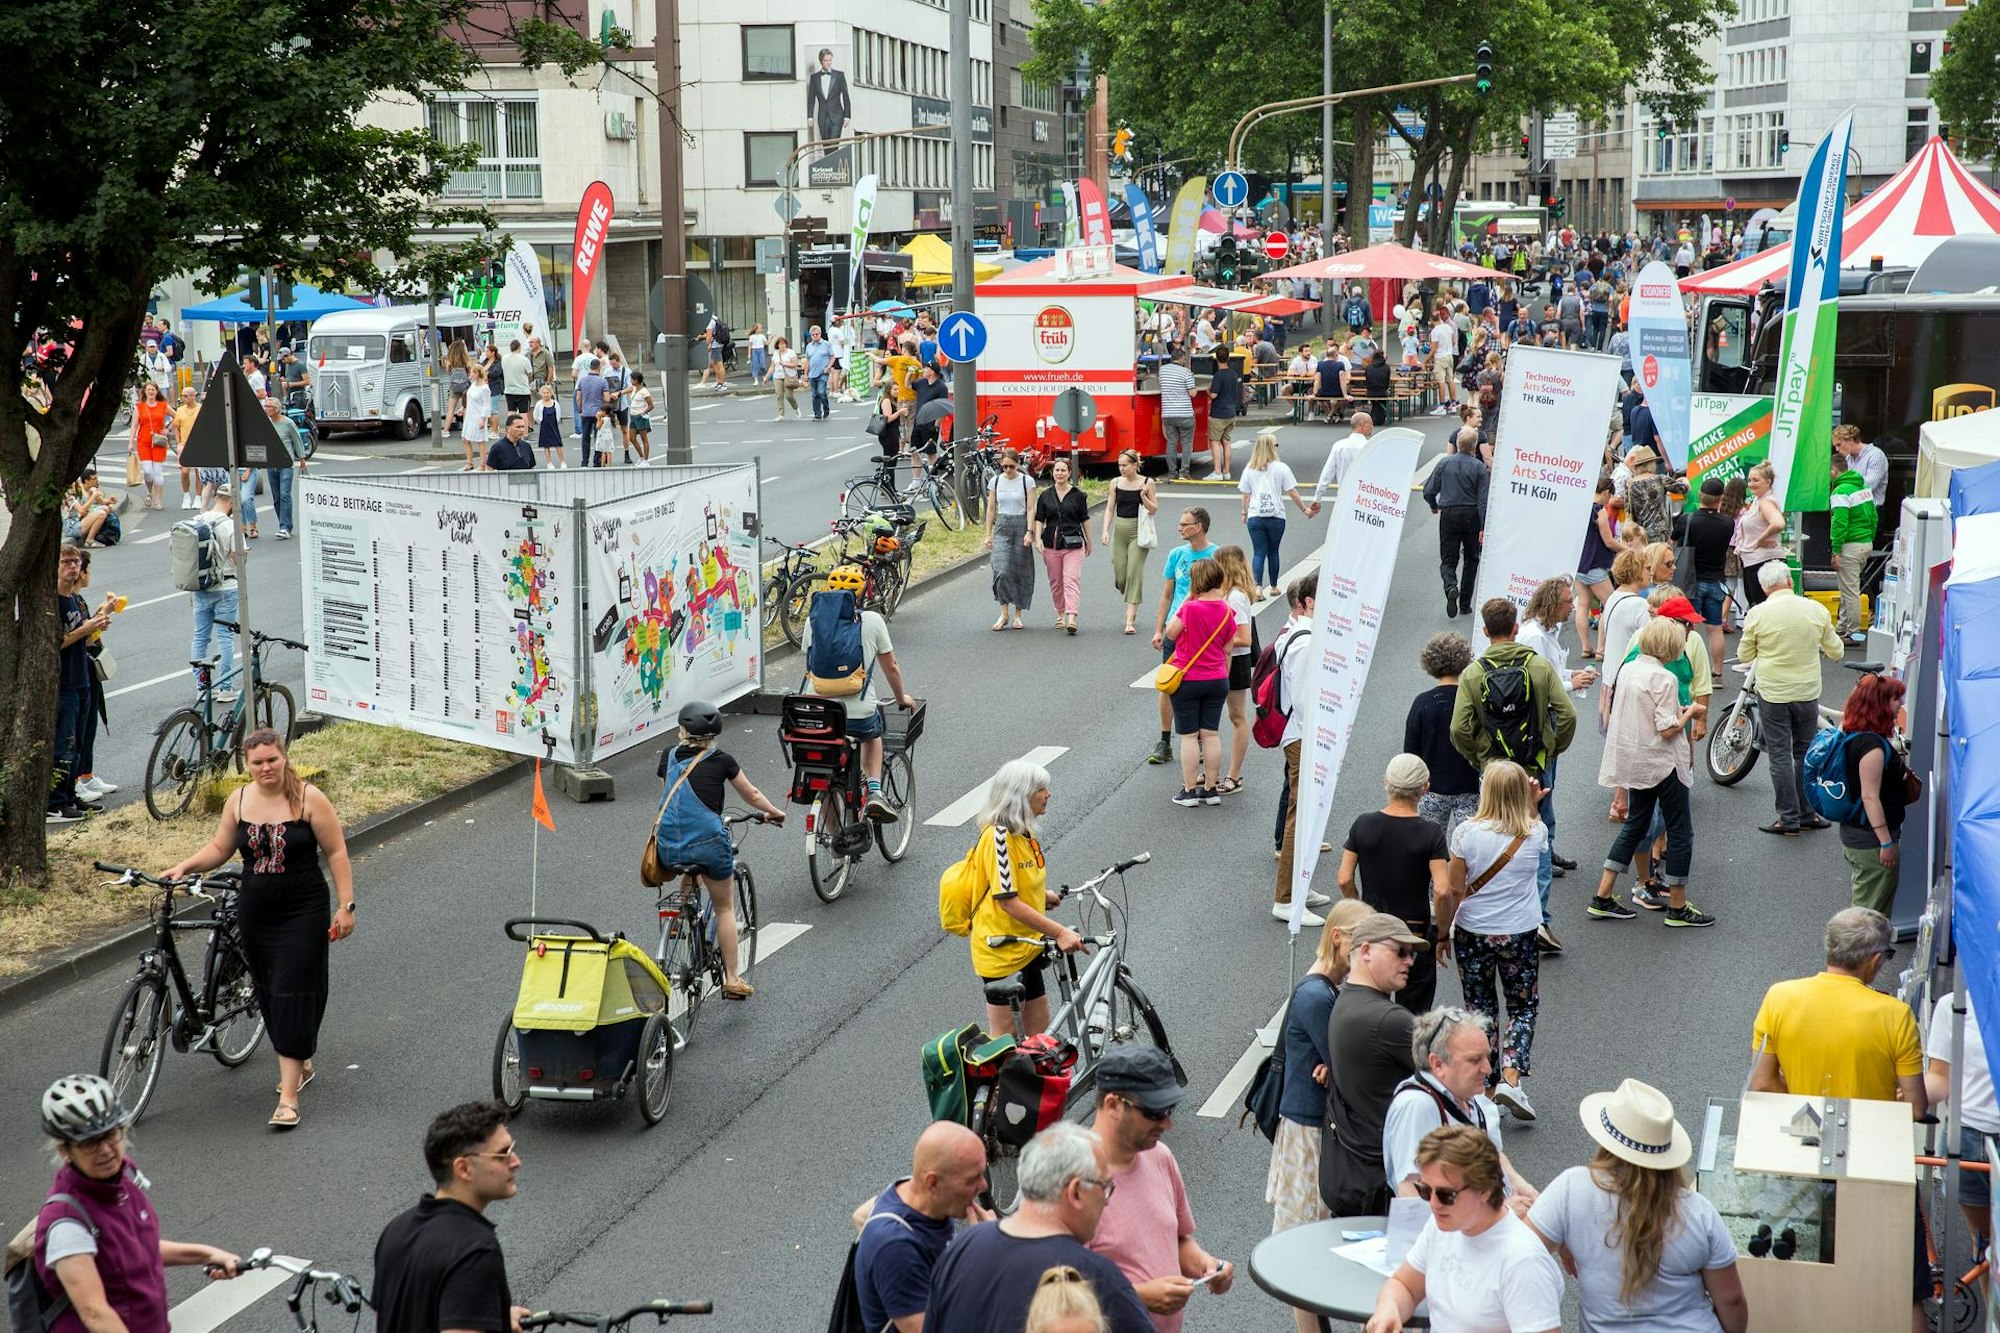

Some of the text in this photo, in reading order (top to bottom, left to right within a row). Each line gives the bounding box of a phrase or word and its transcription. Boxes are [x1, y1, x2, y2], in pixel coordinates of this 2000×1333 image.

[1817, 153, 1838, 246] WIRTSCHAFTSDIENST
[577, 198, 608, 275] REWE
[1133, 202, 1157, 270] IKE
[1040, 330, 1067, 345] früh
[1024, 372, 1084, 381] www.frueh.de
[1525, 370, 1572, 386] Technology
[1002, 384, 1036, 393] CÖLNER
[1523, 382, 1576, 397] Arts Sciences
[1522, 393, 1555, 406] TH Köln
[1694, 397, 1729, 412] JITpay
[1776, 363, 1807, 438] JITpay
[1692, 427, 1726, 456] MAKE
[1696, 428, 1756, 470] TRUCKING
[1515, 448, 1584, 474] Technology
[1702, 455, 1740, 481] GREAT
[1512, 464, 1588, 489] Arts Sciences
[1358, 479, 1400, 505] Technology
[1510, 481, 1558, 502] TH Köln
[305, 492, 382, 513] 19 06 22 BEITRÄGE
[653, 501, 675, 518] 19 06 22
[1355, 494, 1405, 518] Arts Sciences
[1354, 509, 1385, 529] TH Köln
[1508, 584, 1523, 595] Arts
[1510, 573, 1543, 587] Technolo
[1518, 596, 1528, 607] Kö
[600, 615, 614, 636] NORD
